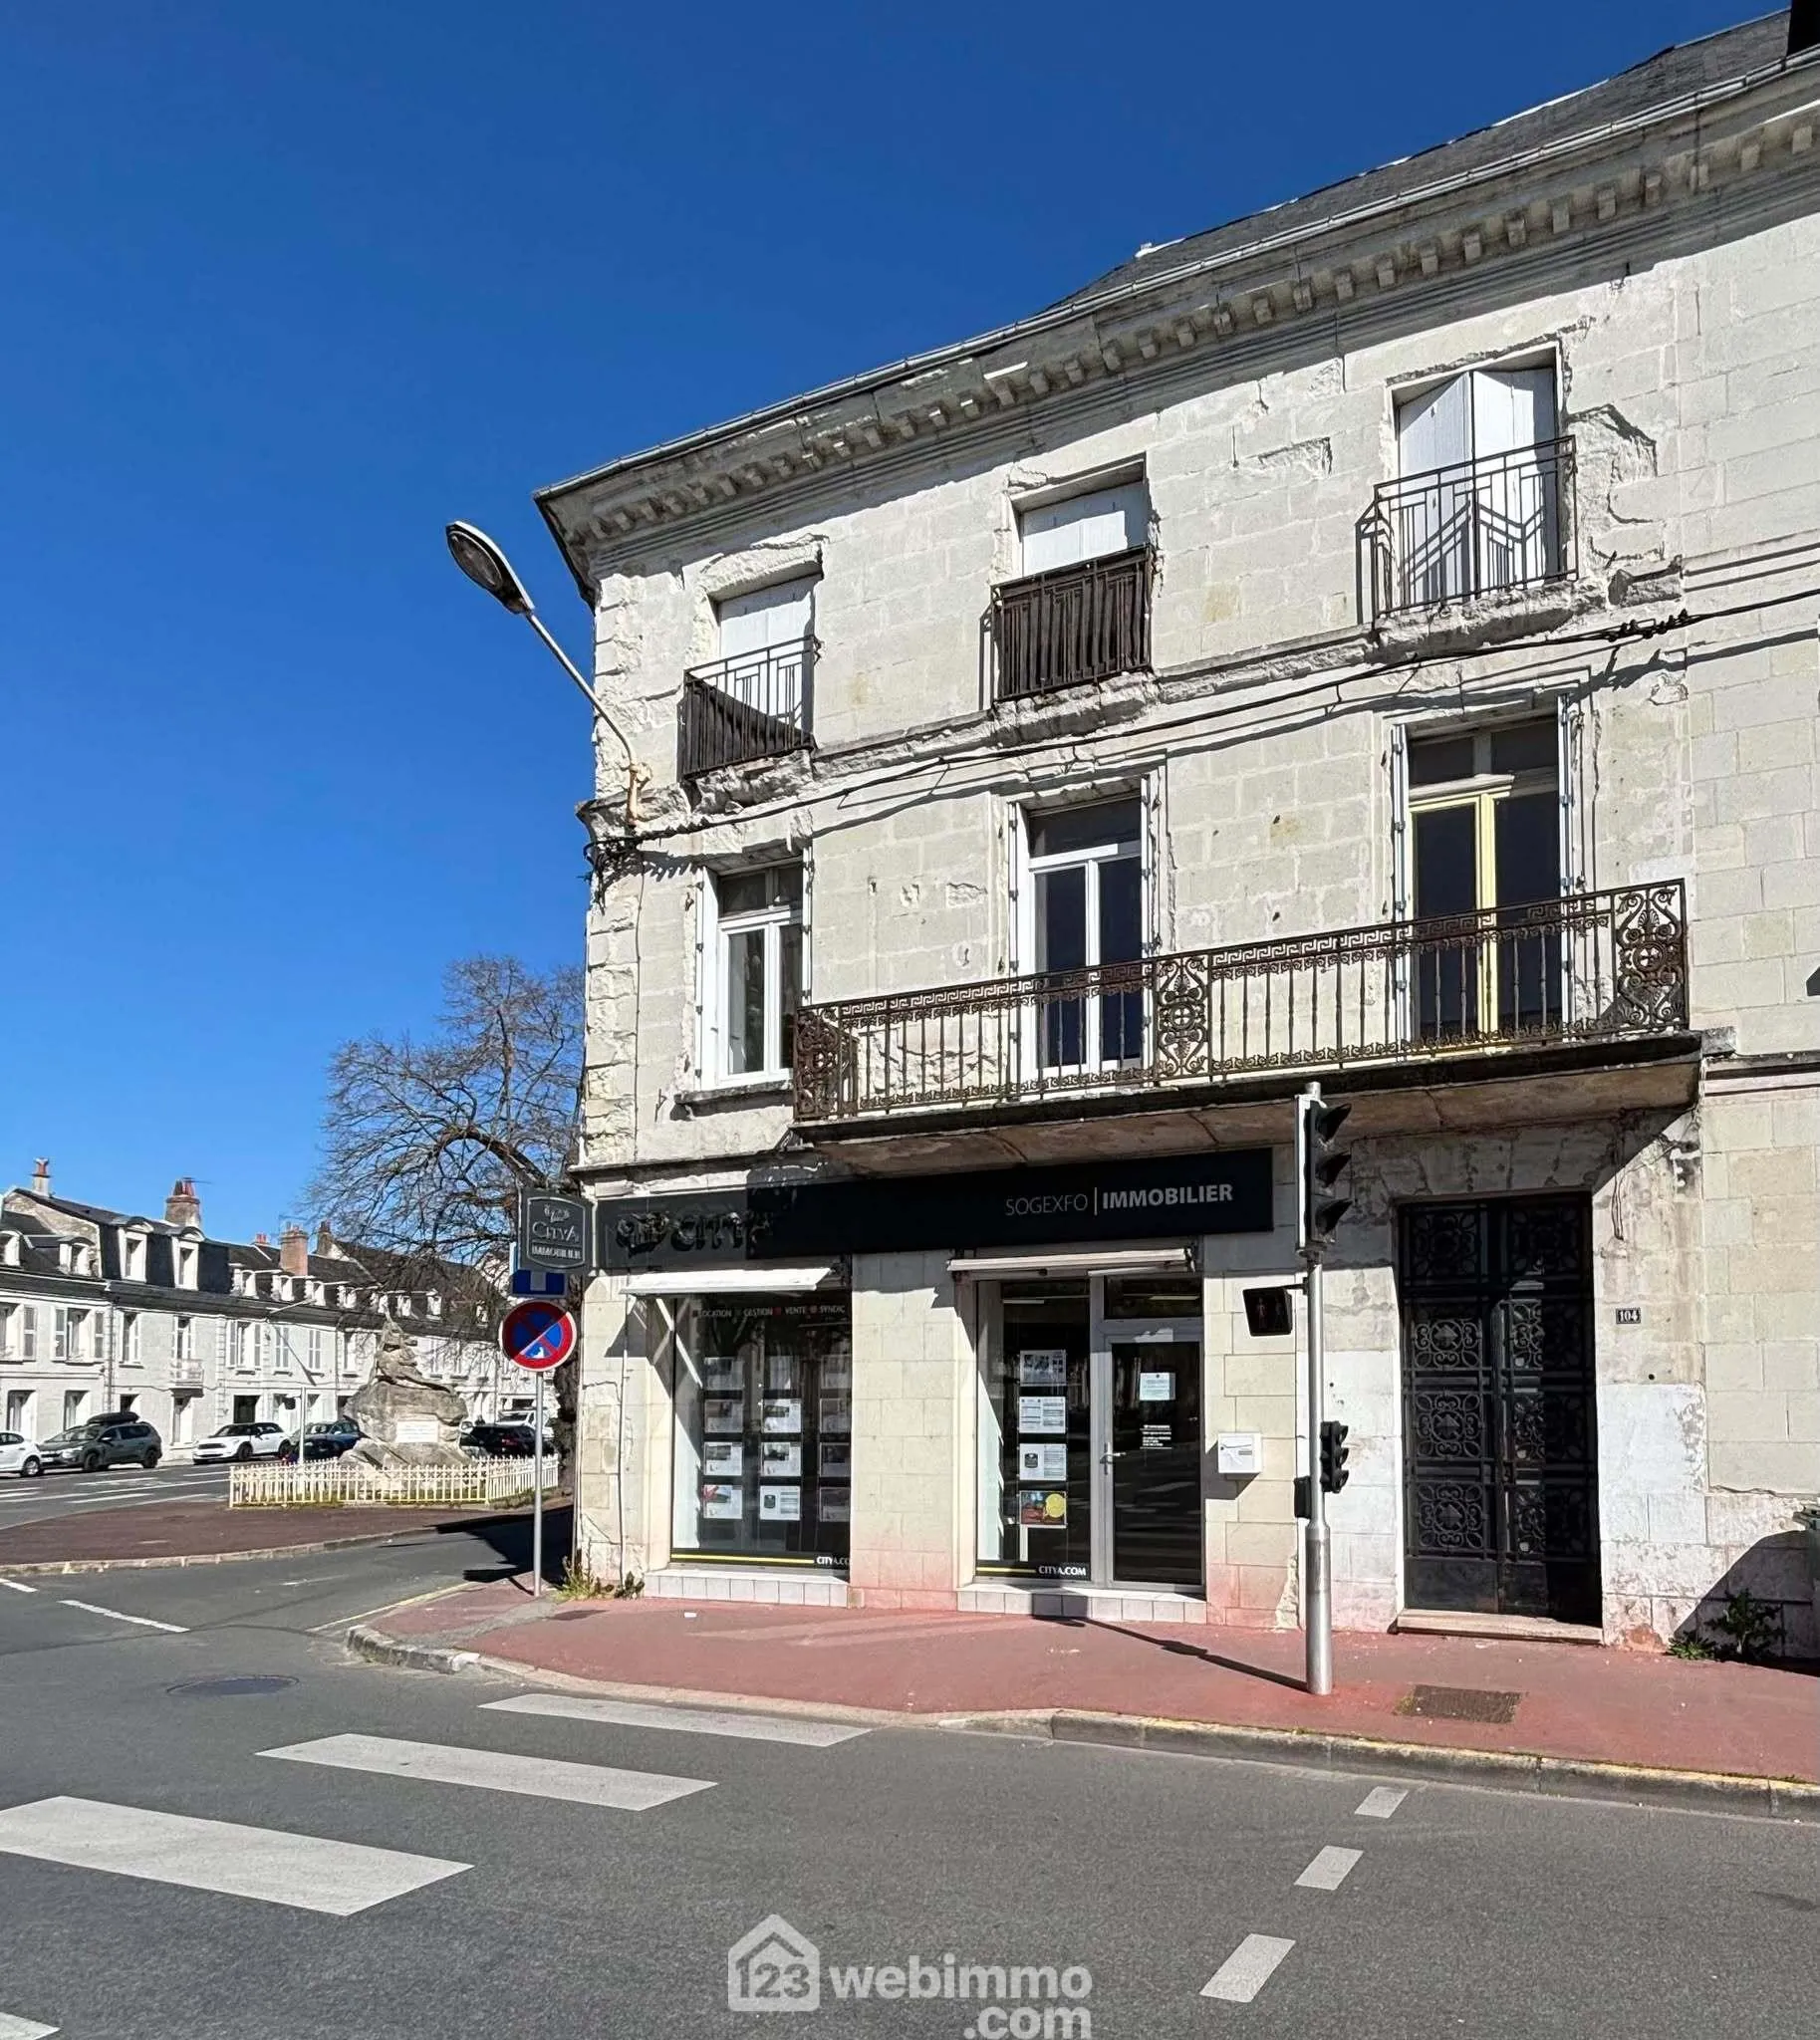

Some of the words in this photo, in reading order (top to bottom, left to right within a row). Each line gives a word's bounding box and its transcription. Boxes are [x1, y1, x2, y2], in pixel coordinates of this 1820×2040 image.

[1005, 1193, 1089, 1216] SOGEXFO
[1102, 1183, 1233, 1209] IMMOBILIER
[1620, 1310, 1639, 1322] 104
[1038, 1565, 1087, 1576] CITYA.COM
